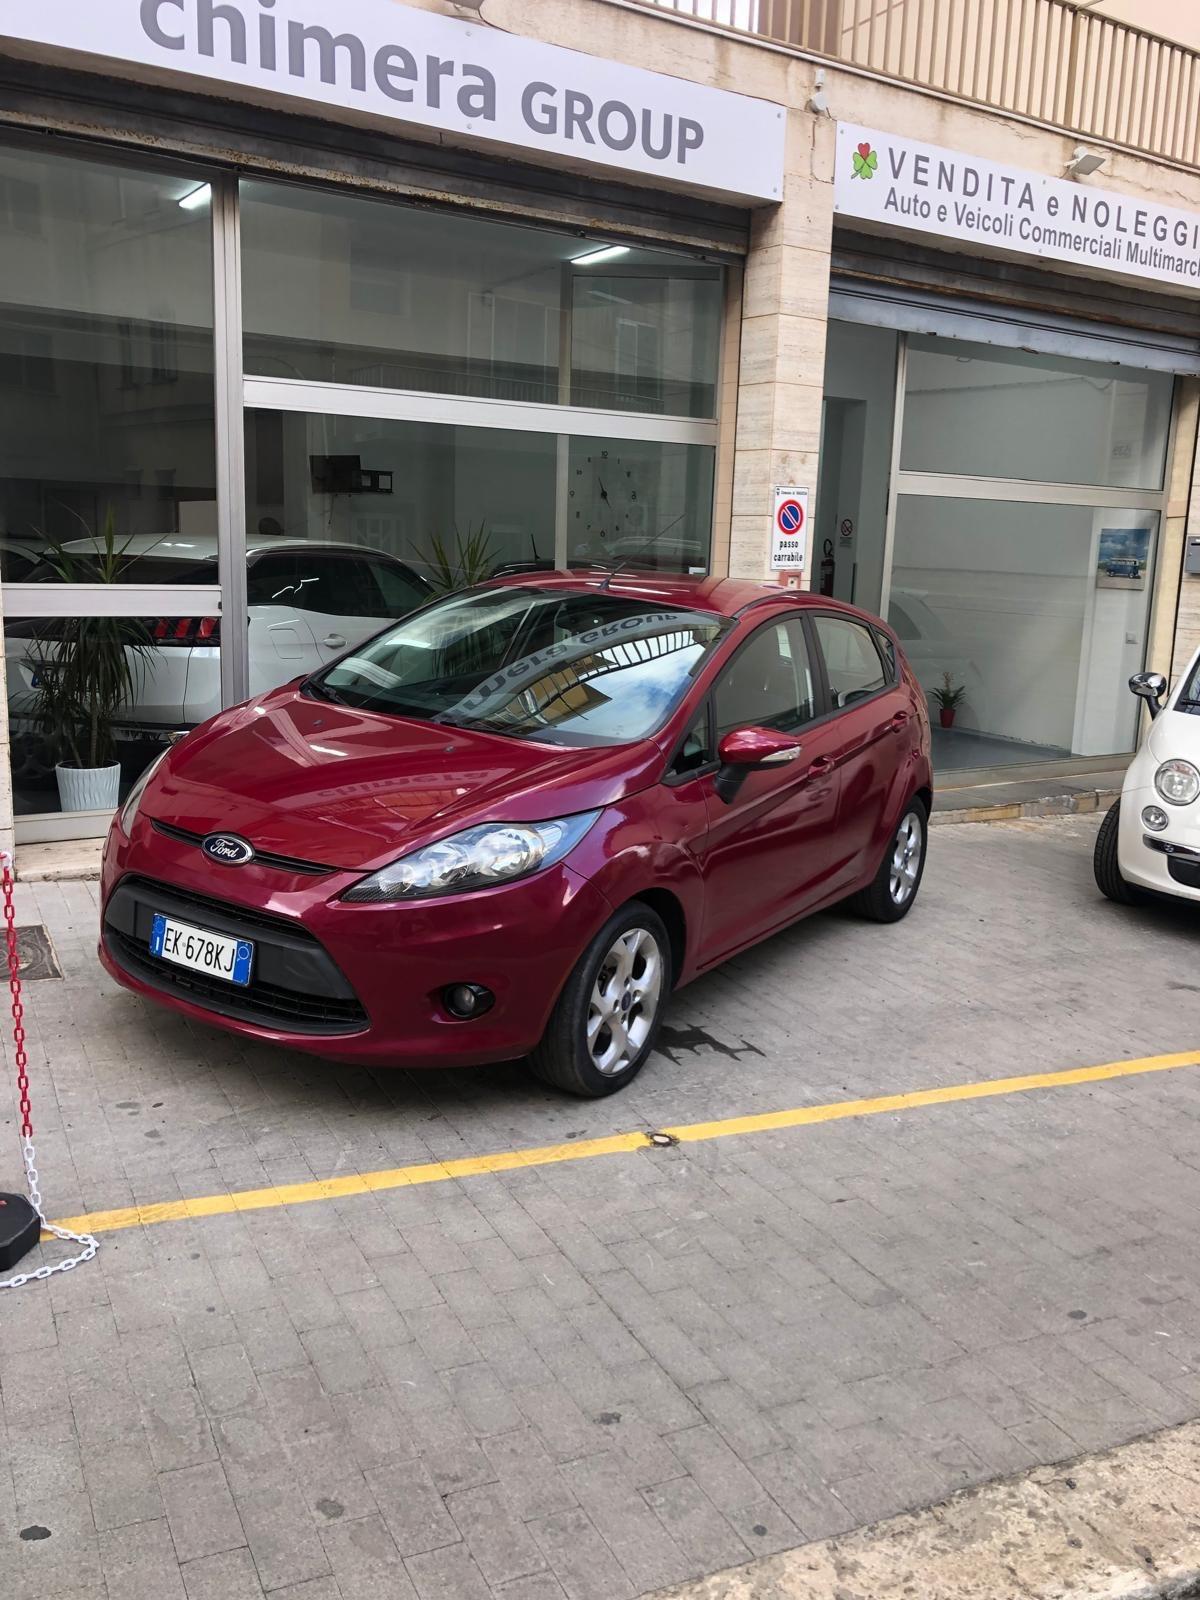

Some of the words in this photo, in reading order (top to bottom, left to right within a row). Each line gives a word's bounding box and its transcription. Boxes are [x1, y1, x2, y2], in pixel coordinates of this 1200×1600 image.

[140, 0, 496, 121] chimera
[521, 81, 704, 165] GROUP
[888, 147, 1034, 211] VENDITA
[1047, 195, 1059, 216] e
[1071, 195, 1199, 250] NOLEGGI
[884, 187, 931, 218] Auto
[937, 204, 947, 222] e
[954, 201, 1013, 236] Veicoli
[1019, 217, 1121, 259] Commerciali
[773, 552, 803, 562] carrabile
[779, 540, 799, 551] passo
[210, 838, 239, 859] Ford
